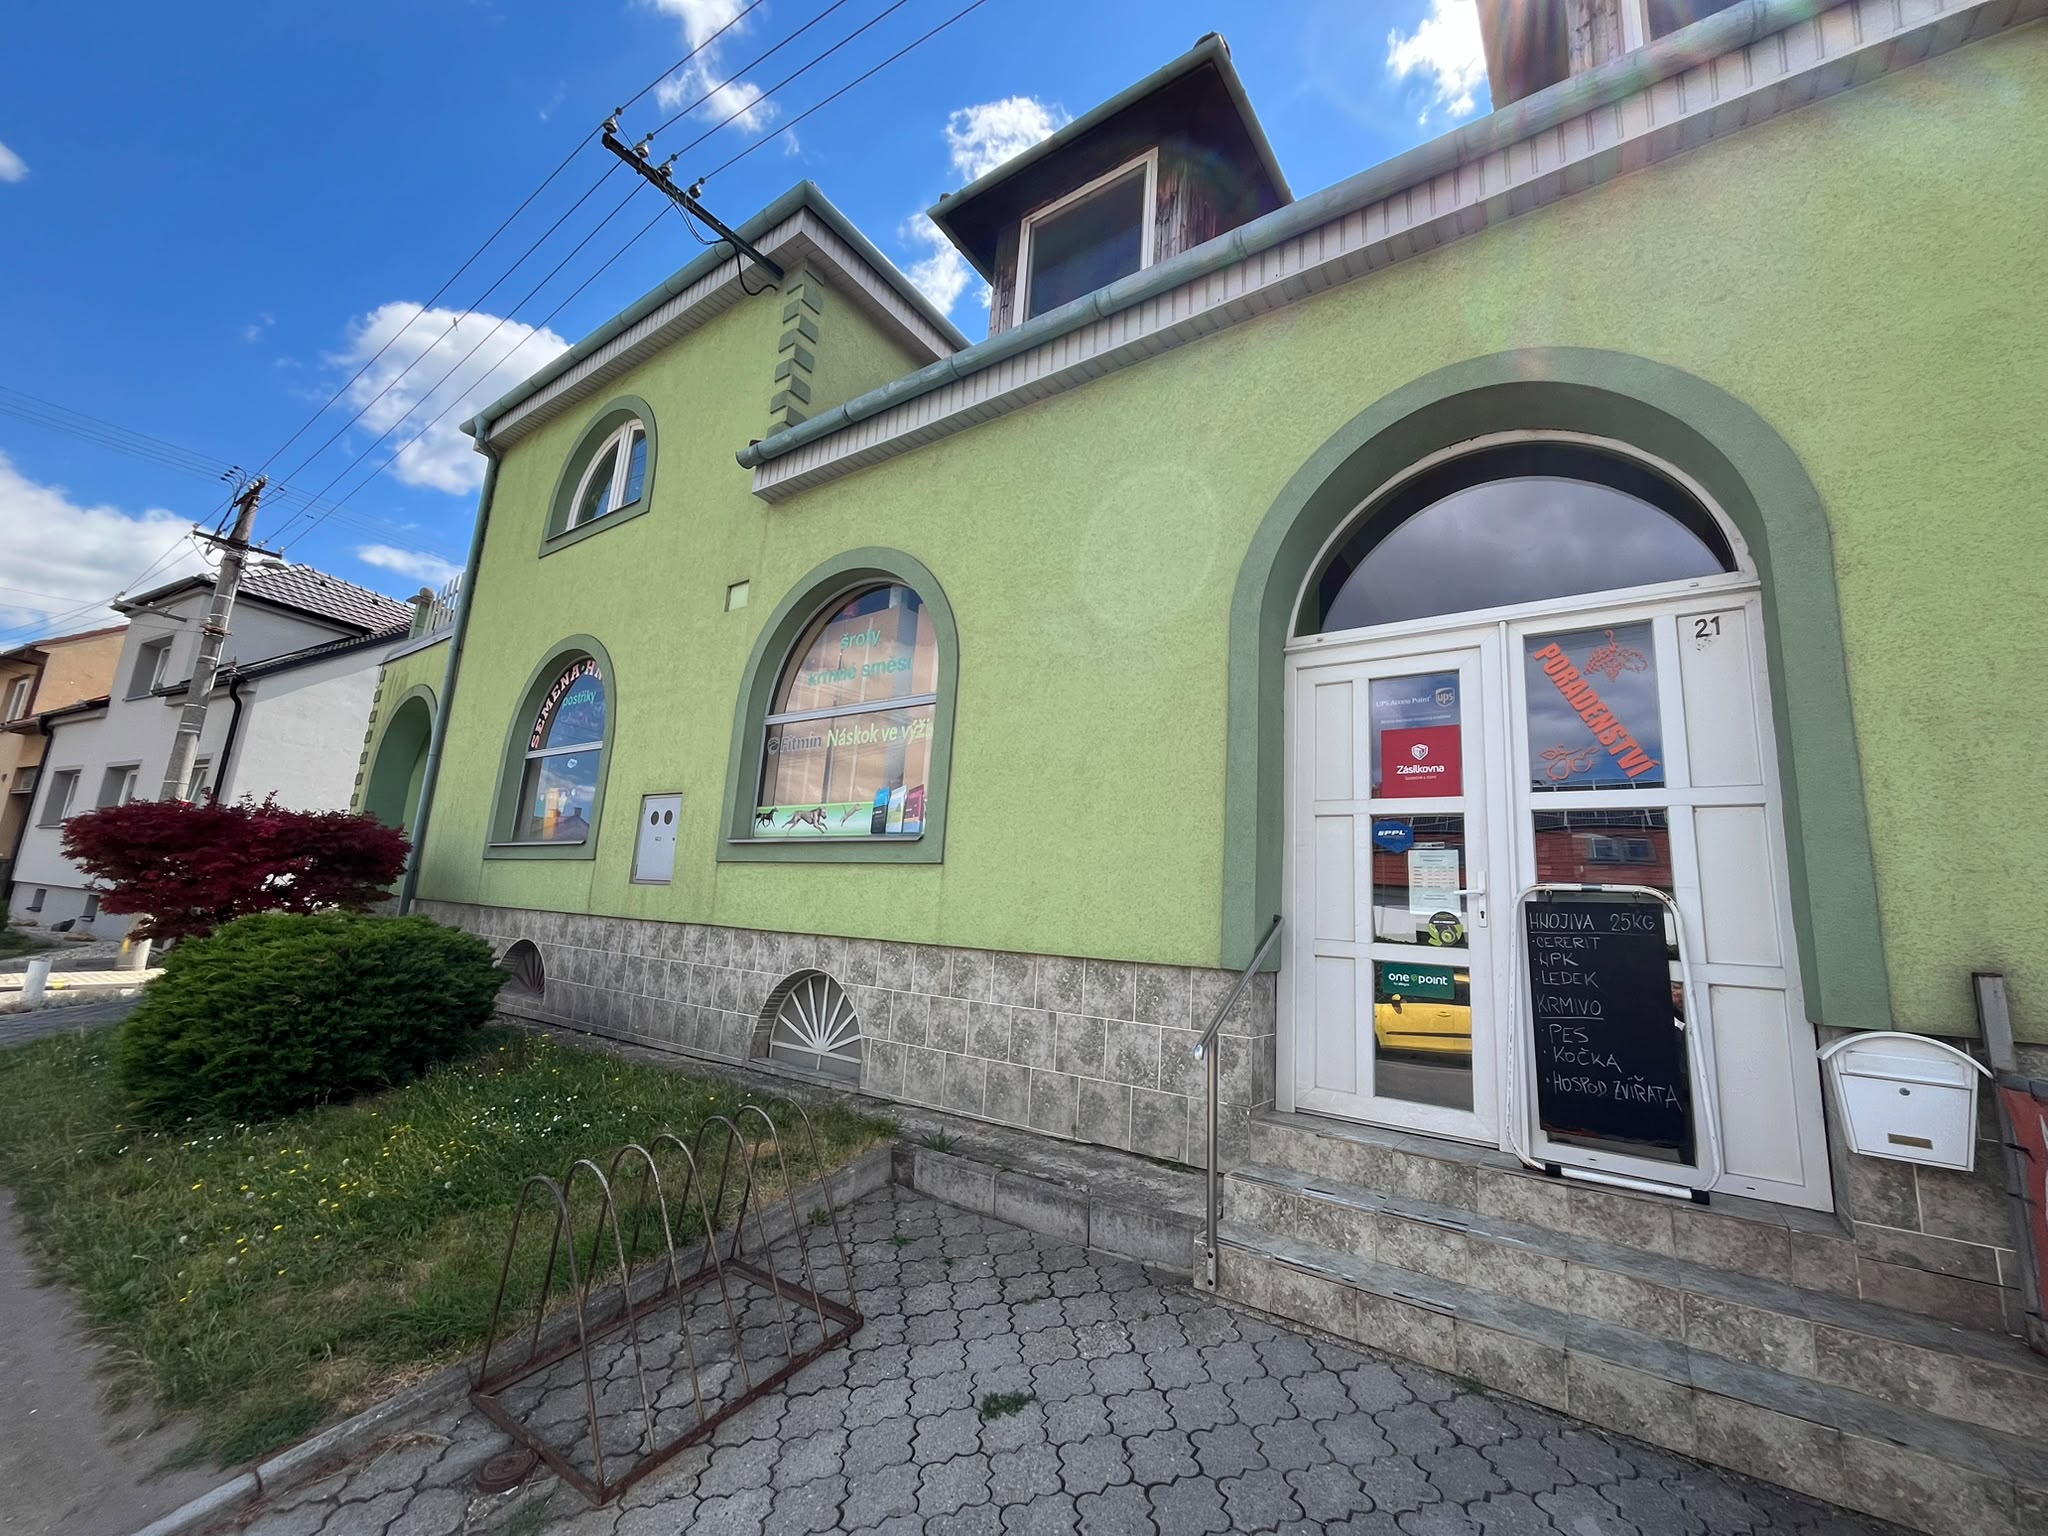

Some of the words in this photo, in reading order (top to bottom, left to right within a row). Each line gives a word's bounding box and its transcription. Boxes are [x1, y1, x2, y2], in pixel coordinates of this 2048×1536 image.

[1694, 616, 1721, 639] 21
[840, 628, 881, 650] šroty
[530, 663, 581, 749] SEMENA
[1437, 692, 1454, 705] ups
[1533, 642, 1661, 779] PORADENSTVÍ
[780, 732, 822, 752] Fitmin
[827, 723, 878, 748] Náskok
[881, 725, 898, 742] ve
[1396, 764, 1445, 775] Zásilkovna
[1529, 912, 1595, 931] HNOJIVA
[1609, 912, 1656, 932] 25KG
[1536, 936, 1601, 949] CERERIT
[1539, 952, 1580, 968] NPK
[1388, 972, 1410, 983] one
[1418, 974, 1448, 986] point
[1541, 971, 1600, 989] LEDEK
[1536, 996, 1602, 1017] KRMIVO
[1548, 1023, 1590, 1044] PES
[1553, 1046, 1623, 1074] KOČKA
